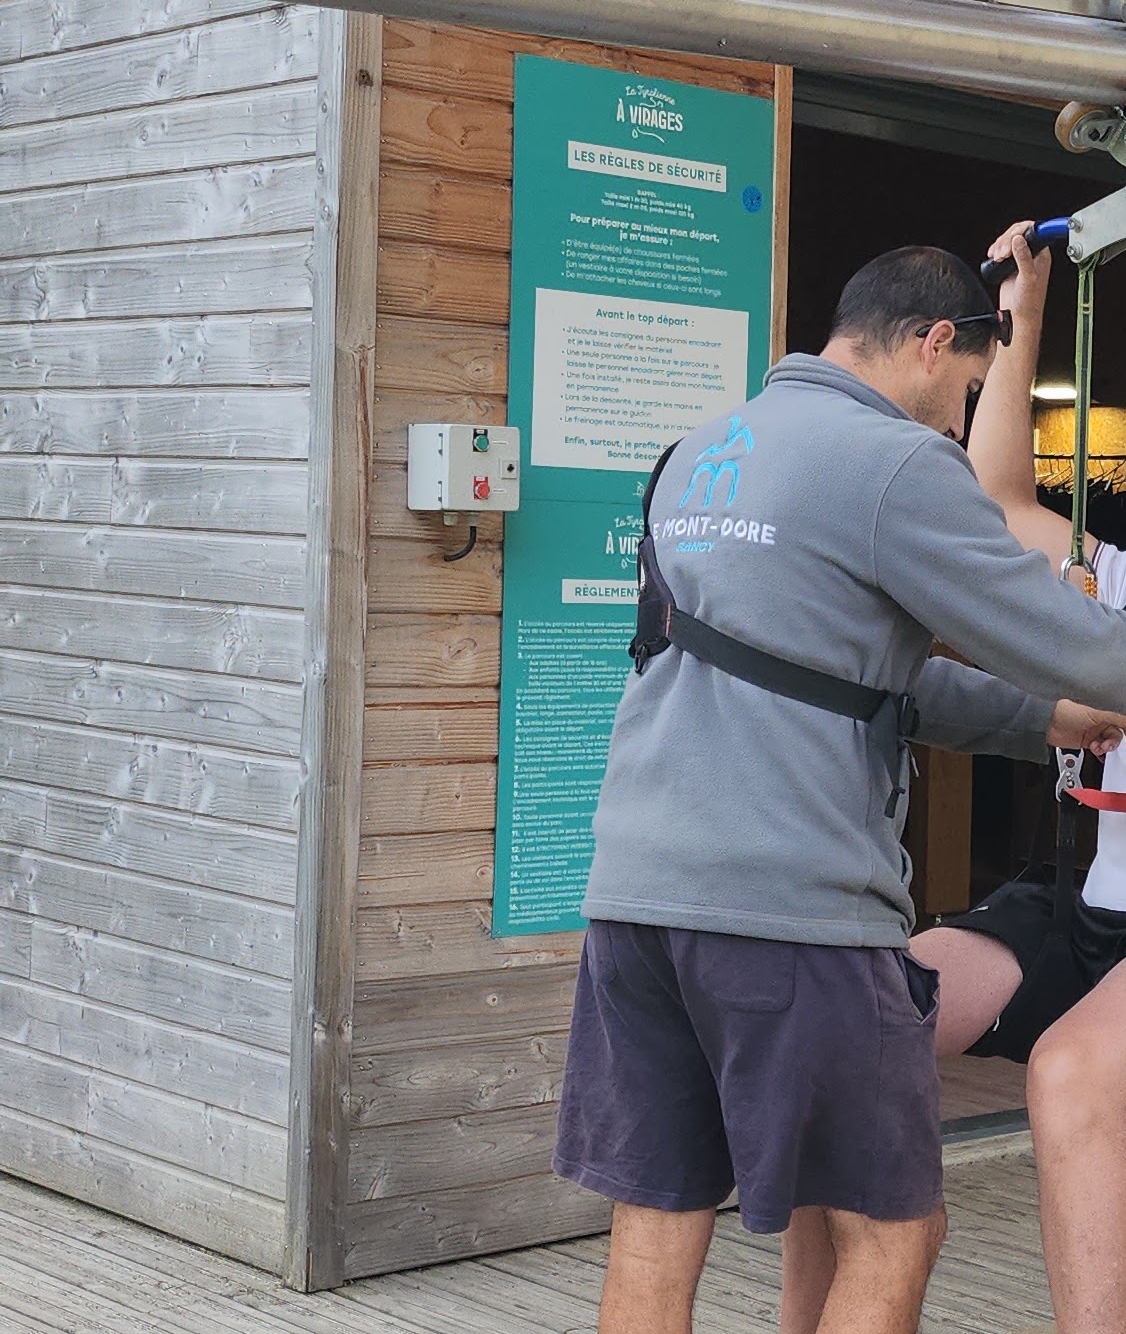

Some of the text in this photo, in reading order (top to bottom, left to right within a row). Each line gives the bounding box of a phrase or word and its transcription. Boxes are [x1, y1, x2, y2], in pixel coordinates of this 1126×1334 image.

[626, 84, 676, 106] La Tyrolienne
[616, 97, 683, 132] À VIRAGES
[574, 149, 722, 184] LES RÈGLES DE SÉCURITÉ
[570, 213, 720, 244] Pour préparer au mieux mon départ,
[619, 230, 627, 241] je
[630, 232, 668, 245] m'assure
[623, 247, 632, 255] de
[566, 249, 576, 257] De
[578, 253, 601, 261] ranger
[645, 259, 661, 268] dans
[663, 261, 675, 270] des
[676, 264, 700, 273] poches
[565, 271, 576, 279] De
[628, 278, 655, 288] cheveux
[596, 309, 624, 319] Avant
[627, 312, 635, 321] le
[638, 313, 654, 326] top
[657, 315, 688, 328] départ
[566, 326, 597, 335] J'écoute
[566, 349, 580, 357] Une
[601, 353, 632, 361] personne
[566, 359, 586, 368] laisse
[566, 371, 580, 379] Une
[582, 372, 595, 380] fois
[633, 377, 650, 385] reste
[565, 393, 580, 401] Lors
[574, 416, 603, 427] freinage
[565, 436, 587, 447] Enfin,
[590, 438, 622, 449] surtout,
[625, 440, 631, 450] je
[634, 441, 660, 450] profite
[607, 450, 631, 459] Bonne
[652, 515, 776, 546] E MONT-DORE
[606, 531, 639, 555] À VIR
[676, 539, 715, 553] SANCY
